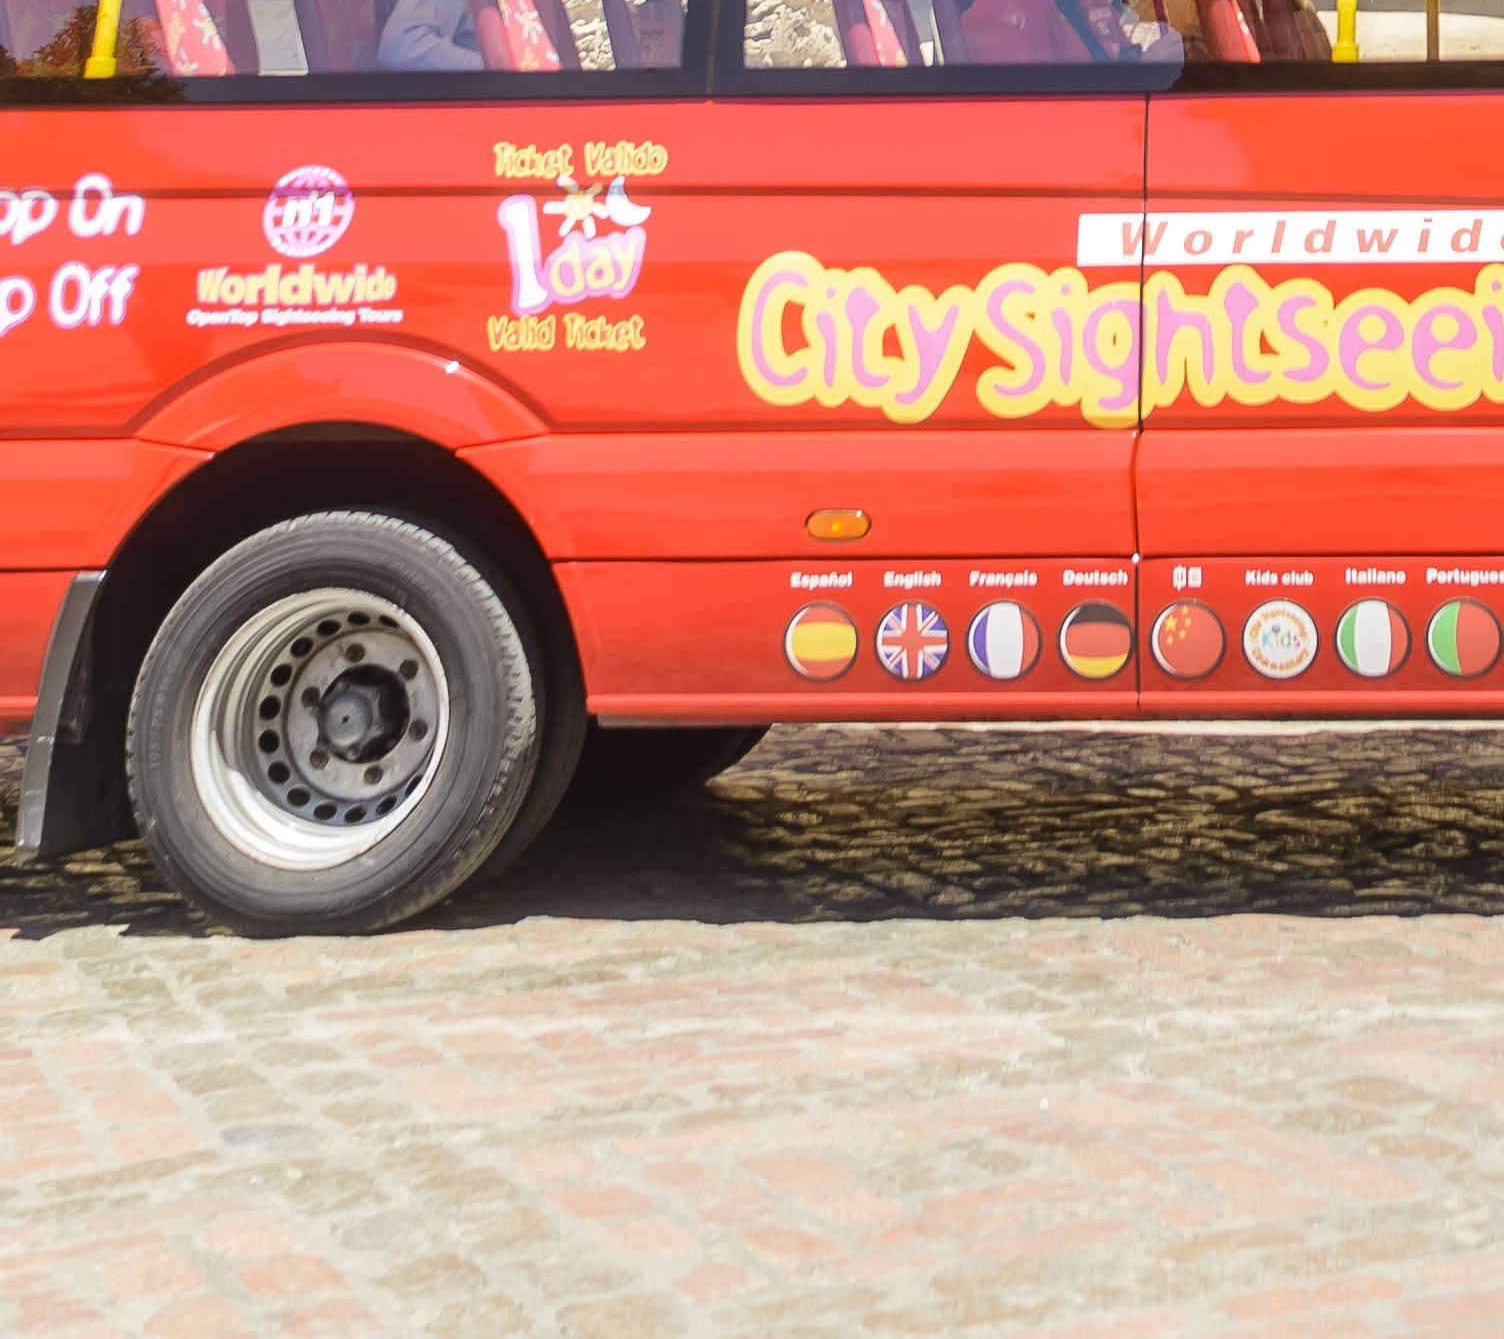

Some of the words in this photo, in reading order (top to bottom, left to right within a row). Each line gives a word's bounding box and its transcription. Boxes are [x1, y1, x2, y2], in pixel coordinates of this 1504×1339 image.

[493, 141, 575, 179] Ticket
[68, 172, 145, 238] On
[497, 193, 549, 316] 1
[544, 226, 647, 304] day
[48, 261, 141, 329] Off
[198, 263, 397, 306] Worldwide
[357, 307, 404, 323] Tours
[487, 314, 556, 352] Valid
[563, 312, 646, 352] Ticket
[790, 571, 853, 590] Español
[883, 570, 942, 589] English
[969, 569, 1038, 589] Français
[1062, 569, 1128, 586] Deutsch
[1245, 569, 1279, 586] Kids
[1281, 570, 1314, 586] club
[1345, 567, 1407, 585] Italiano
[1262, 626, 1301, 650] Kids
